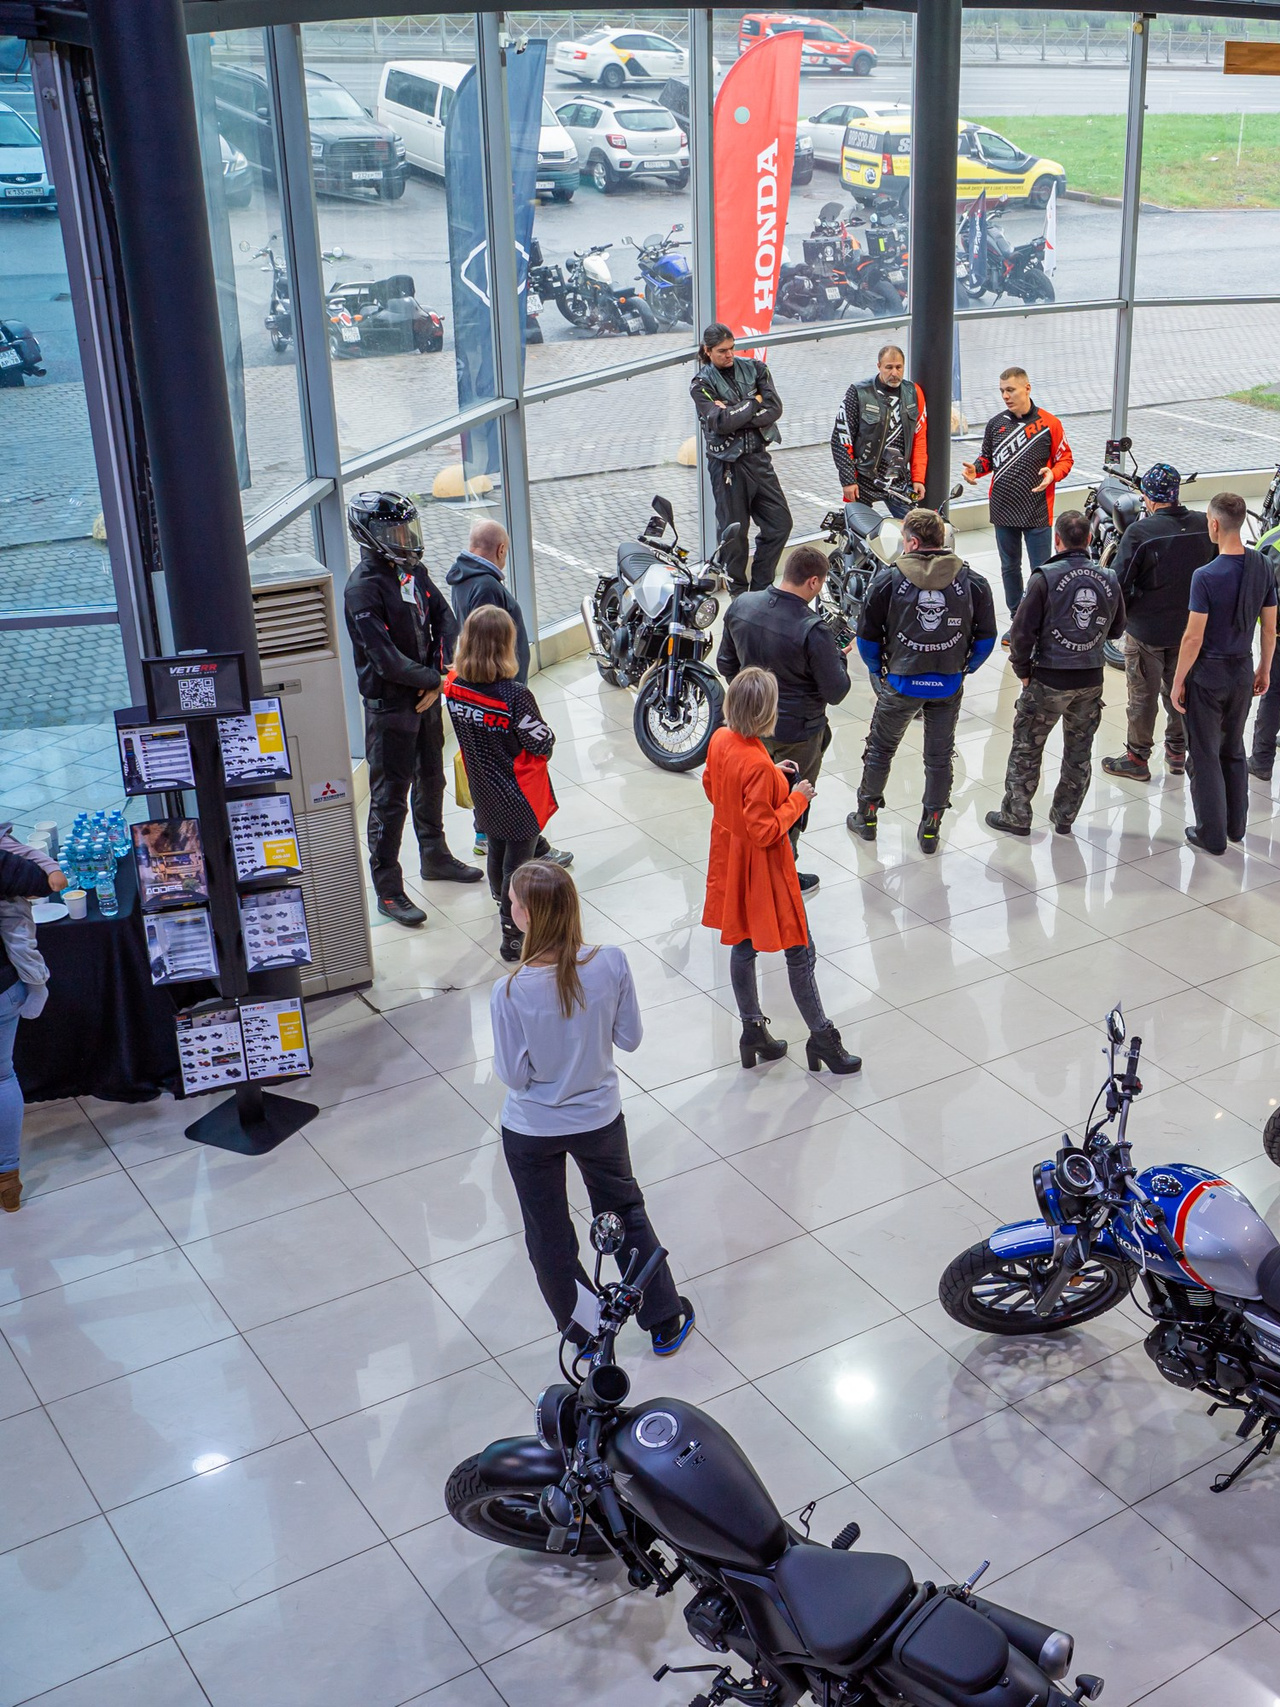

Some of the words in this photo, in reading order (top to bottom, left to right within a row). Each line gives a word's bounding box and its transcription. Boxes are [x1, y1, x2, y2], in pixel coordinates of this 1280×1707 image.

[754, 138, 779, 314] HONDA
[709, 432, 736, 452] RUSSI
[1056, 577, 1071, 593] THE
[1070, 569, 1113, 598] HOOLIGANS
[169, 664, 217, 675] VETERR
[912, 680, 945, 688] HONDA
[1116, 1234, 1164, 1262] HONDA
